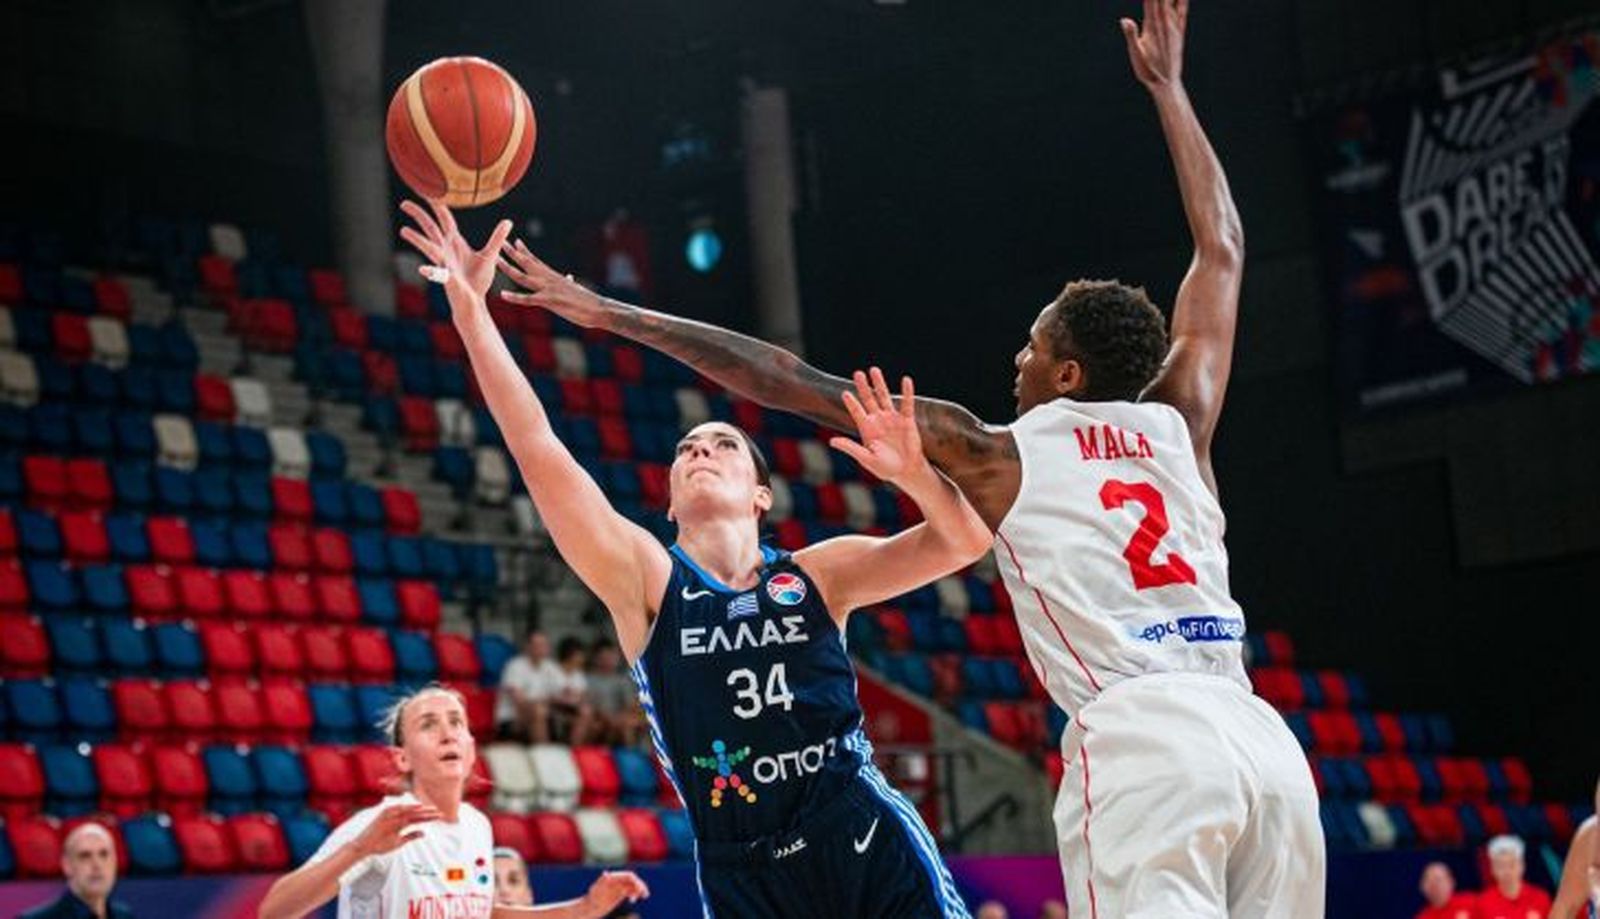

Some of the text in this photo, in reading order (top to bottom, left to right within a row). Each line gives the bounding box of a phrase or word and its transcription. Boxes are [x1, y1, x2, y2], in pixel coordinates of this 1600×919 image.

[1402, 150, 1533, 262] DARE
[1098, 478, 1197, 591] 2
[680, 614, 809, 656] ΕΛΛΑΣ
[726, 662, 795, 719] 34
